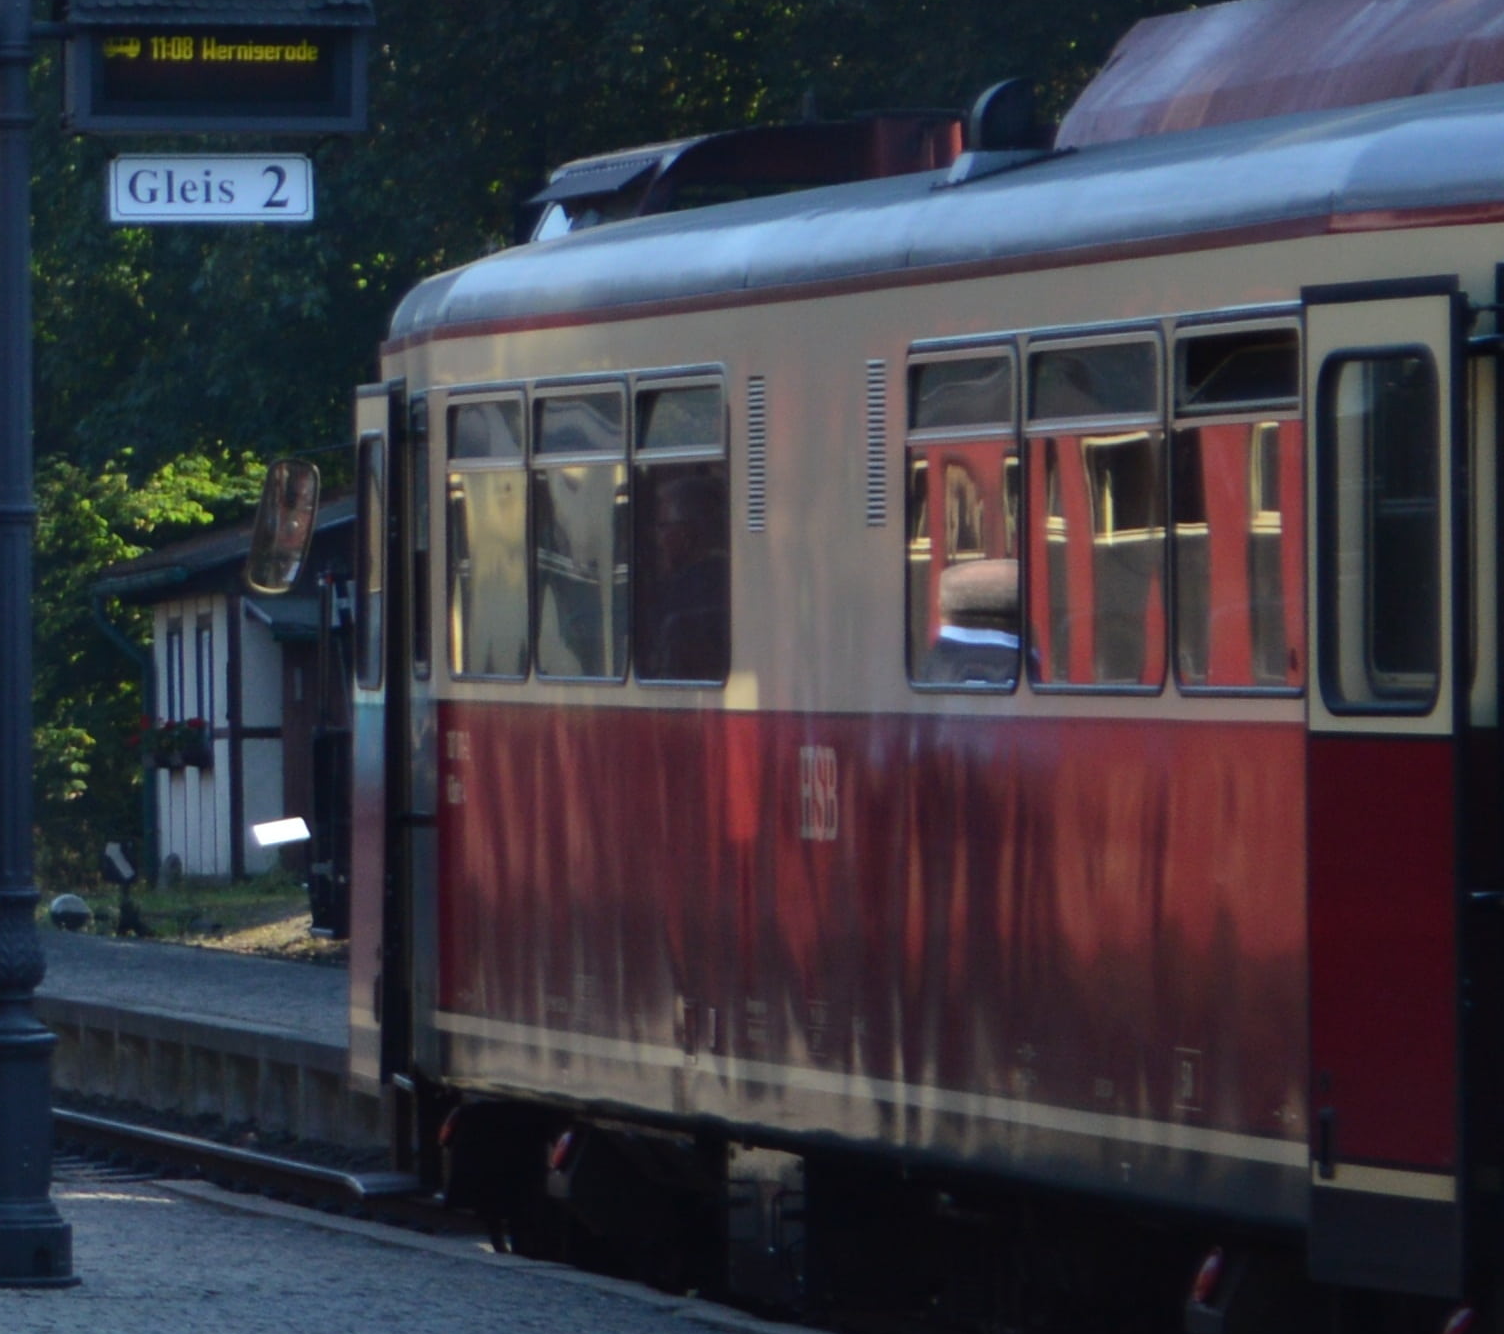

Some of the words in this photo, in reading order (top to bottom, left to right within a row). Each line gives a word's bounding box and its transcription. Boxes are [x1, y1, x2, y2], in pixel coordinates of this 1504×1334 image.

[150, 36, 194, 60] 11:08
[128, 169, 235, 205] Gleis
[262, 165, 290, 208] 2
[800, 745, 839, 843] HSB
